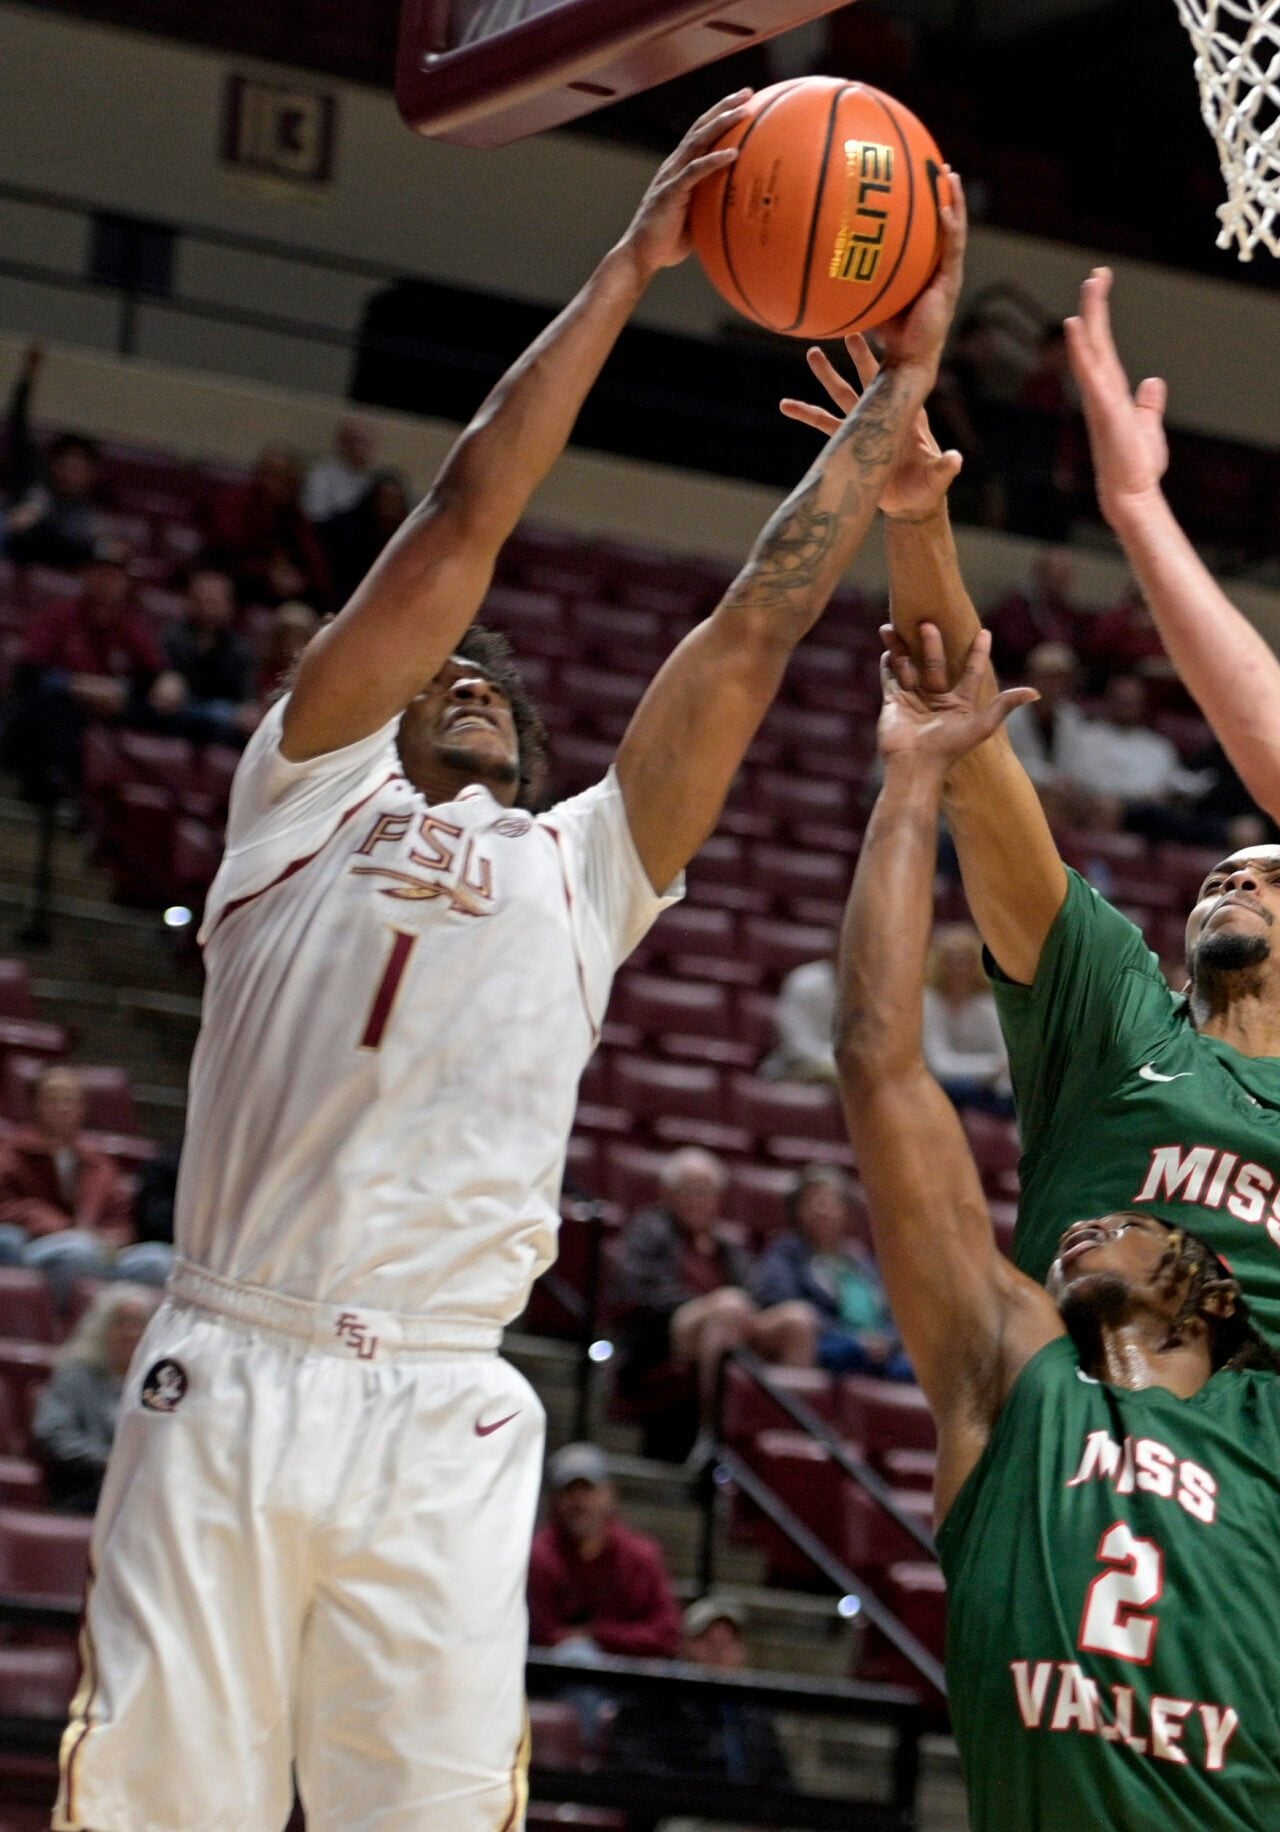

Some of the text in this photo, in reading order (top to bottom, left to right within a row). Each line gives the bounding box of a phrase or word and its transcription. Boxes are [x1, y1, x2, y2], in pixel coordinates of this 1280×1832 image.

[841, 144, 893, 283] ELITE
[353, 812, 494, 900] FSU
[356, 925, 419, 1053] 1
[335, 1312, 379, 1361] FSU
[1065, 1429, 1218, 1525] MISS
[1078, 1519, 1164, 1666] 2
